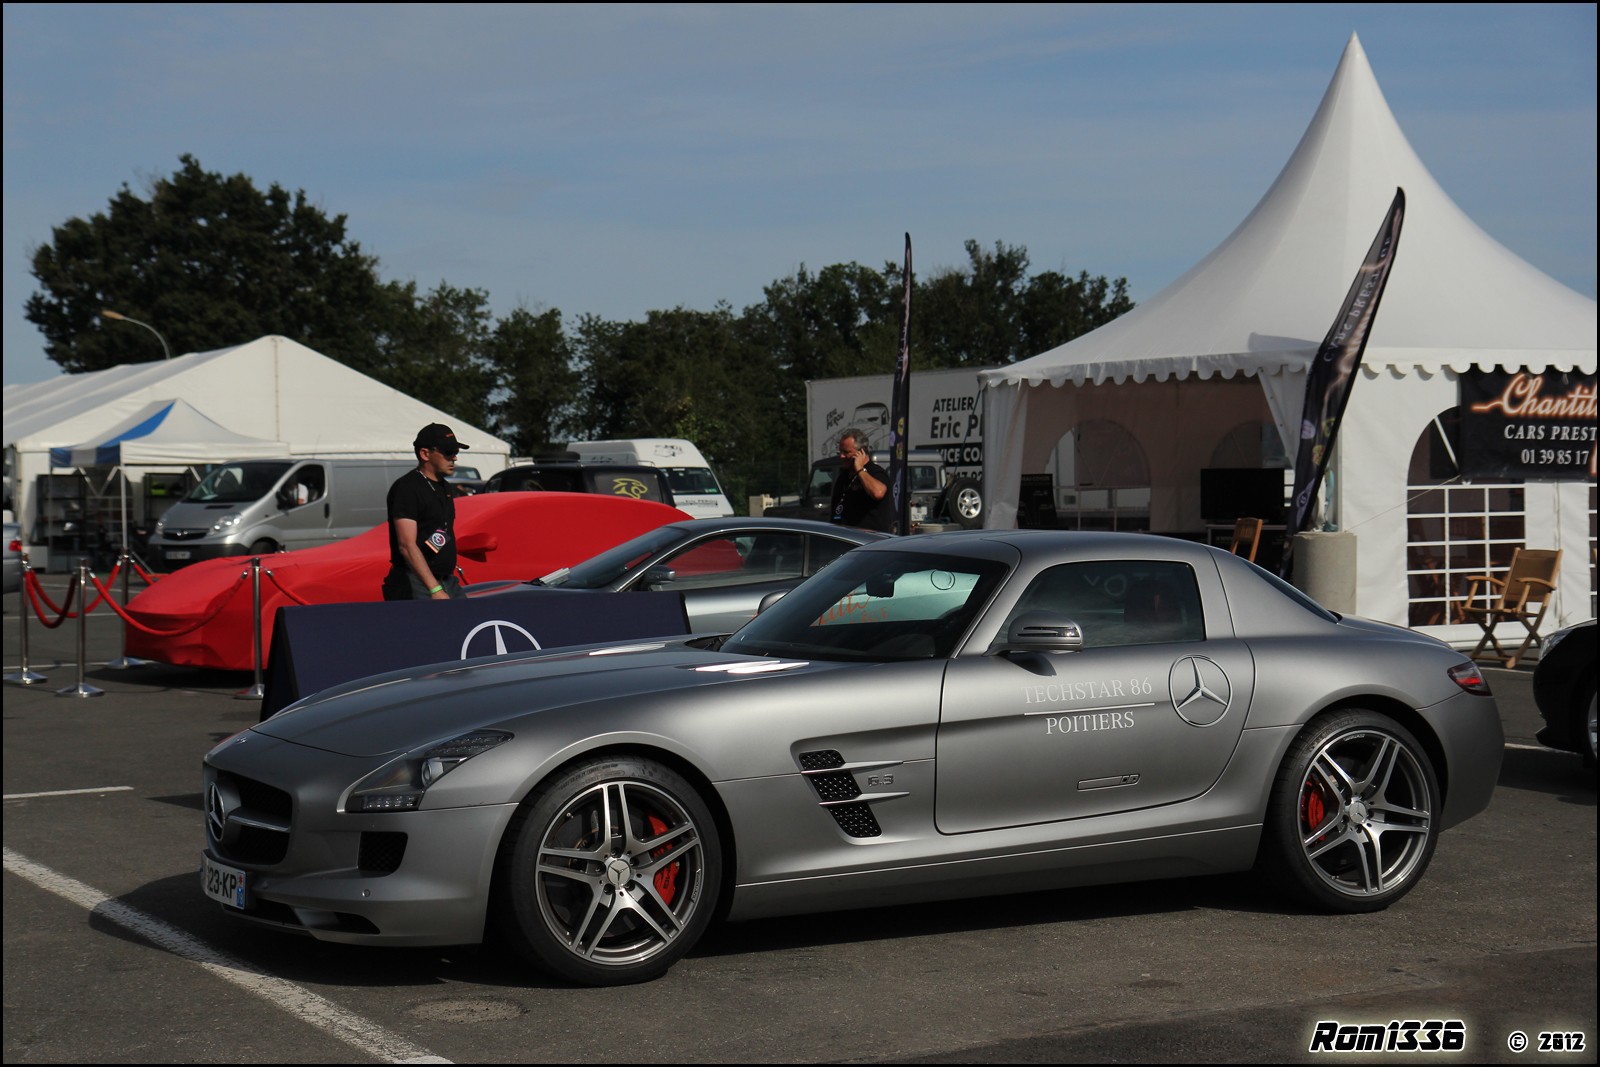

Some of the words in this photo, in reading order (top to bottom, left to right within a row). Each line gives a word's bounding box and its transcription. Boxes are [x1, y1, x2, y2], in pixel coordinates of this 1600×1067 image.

[932, 396, 974, 413] ATELIER
[1500, 373, 1597, 417] Chantil
[930, 415, 961, 439] Eric
[1503, 424, 1546, 440] CARS
[1550, 426, 1597, 441] PREST
[963, 446, 983, 463] CO
[1521, 448, 1536, 464] 01
[1538, 449, 1555, 465] 39
[1556, 449, 1572, 465] 85
[1575, 450, 1590, 465] 17
[1021, 678, 1126, 704] TECHSTAR
[1130, 676, 1153, 696] 86
[1045, 711, 1135, 735] POITIERS
[867, 773, 894, 787] 6.3
[206, 865, 237, 900] 23-KP
